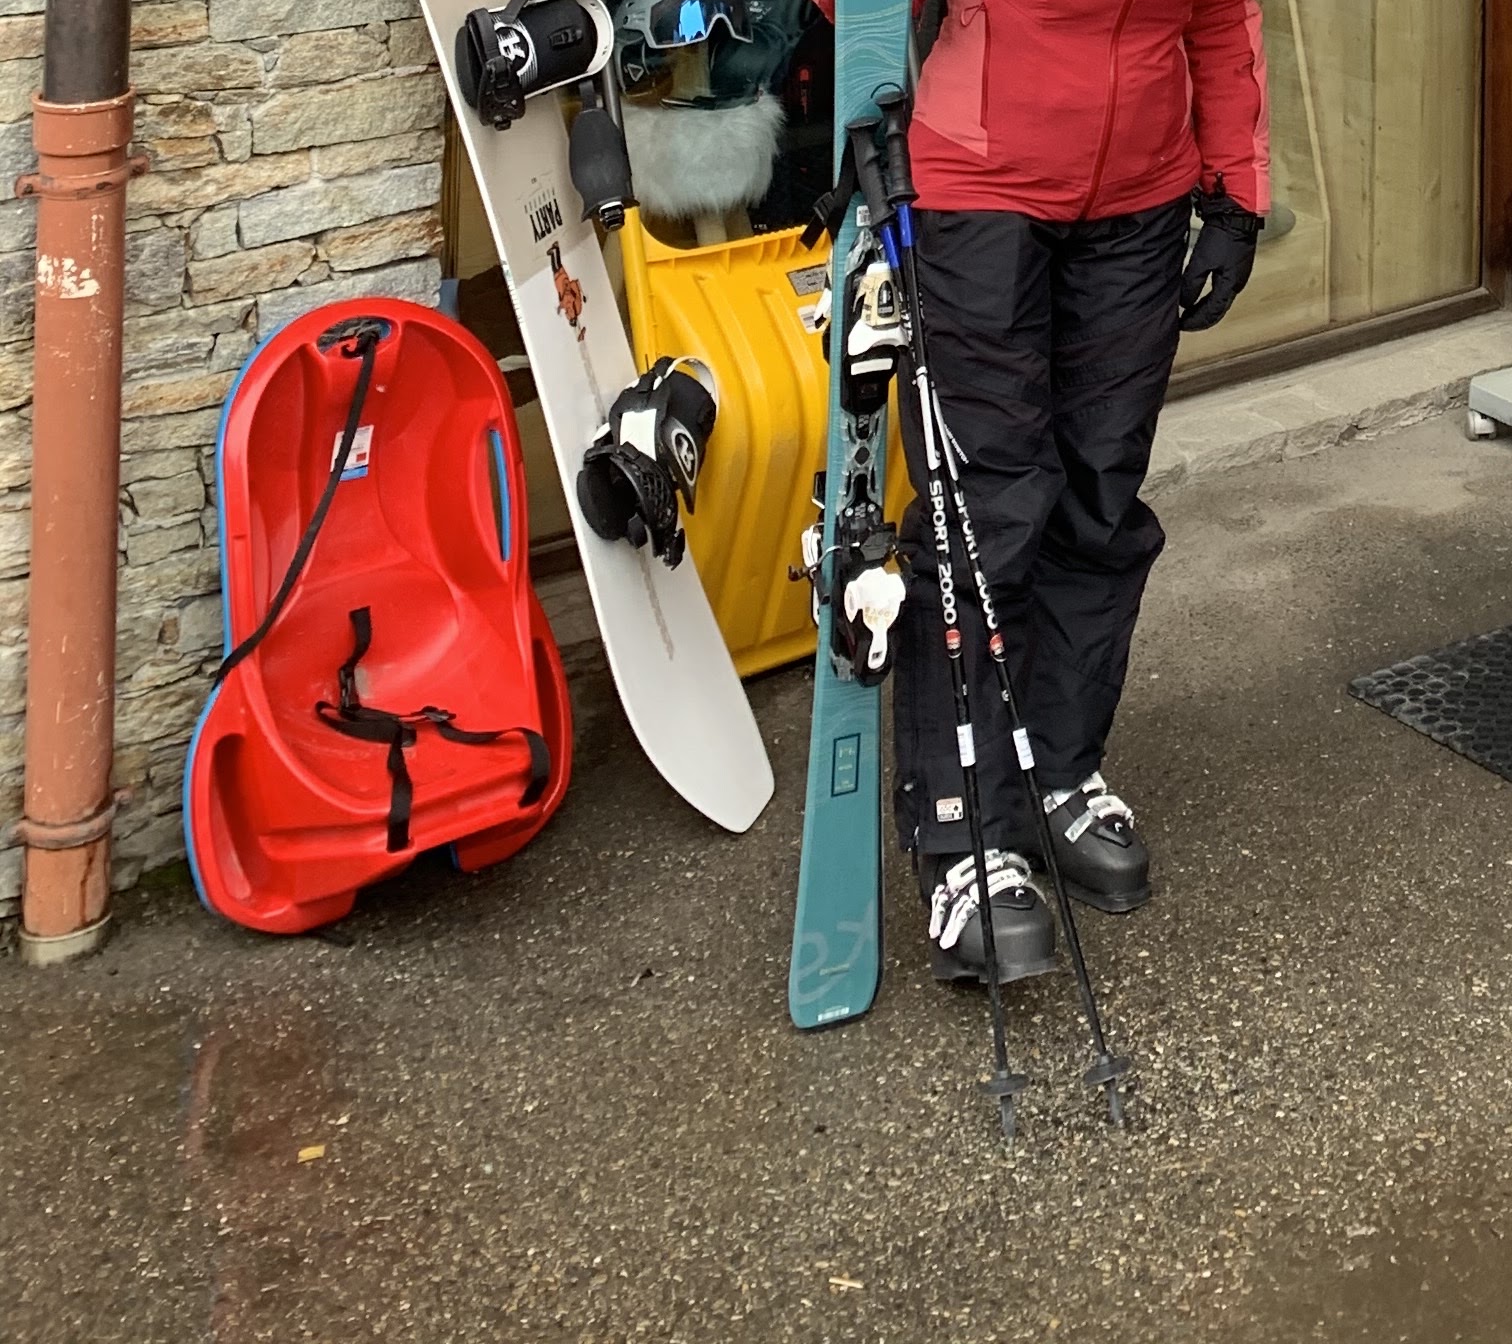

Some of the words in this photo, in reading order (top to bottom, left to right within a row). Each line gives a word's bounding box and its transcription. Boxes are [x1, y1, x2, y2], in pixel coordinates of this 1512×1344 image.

[529, 198, 563, 244] PARTY
[929, 480, 951, 554] SPORT
[938, 562, 957, 625] 2000
